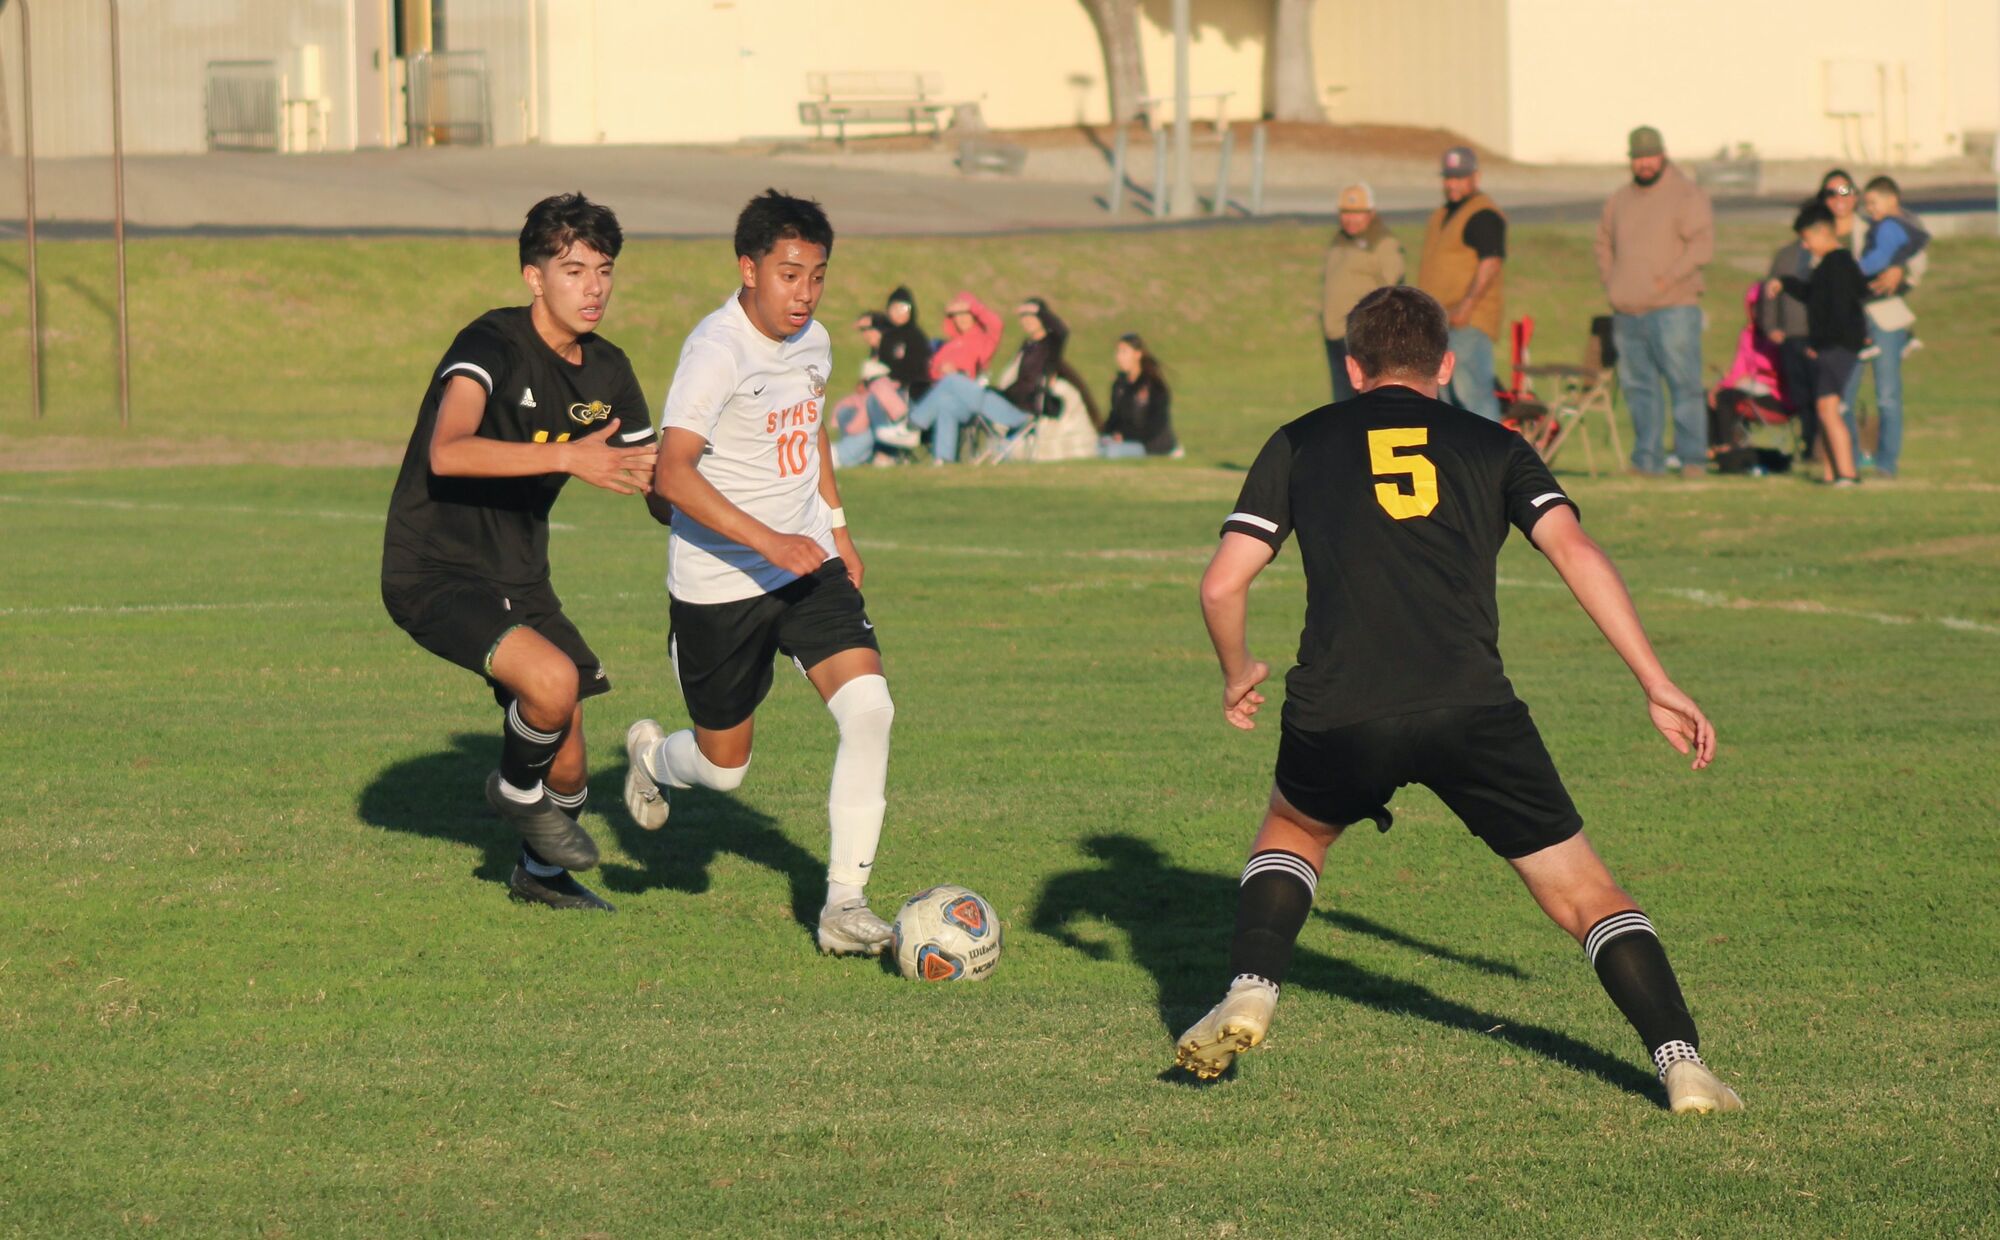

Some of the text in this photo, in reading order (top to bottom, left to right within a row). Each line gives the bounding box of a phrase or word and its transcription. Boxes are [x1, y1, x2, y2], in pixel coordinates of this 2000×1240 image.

[776, 430, 808, 478] 10
[1367, 427, 1439, 520] 5
[968, 942, 998, 959] Wilson
